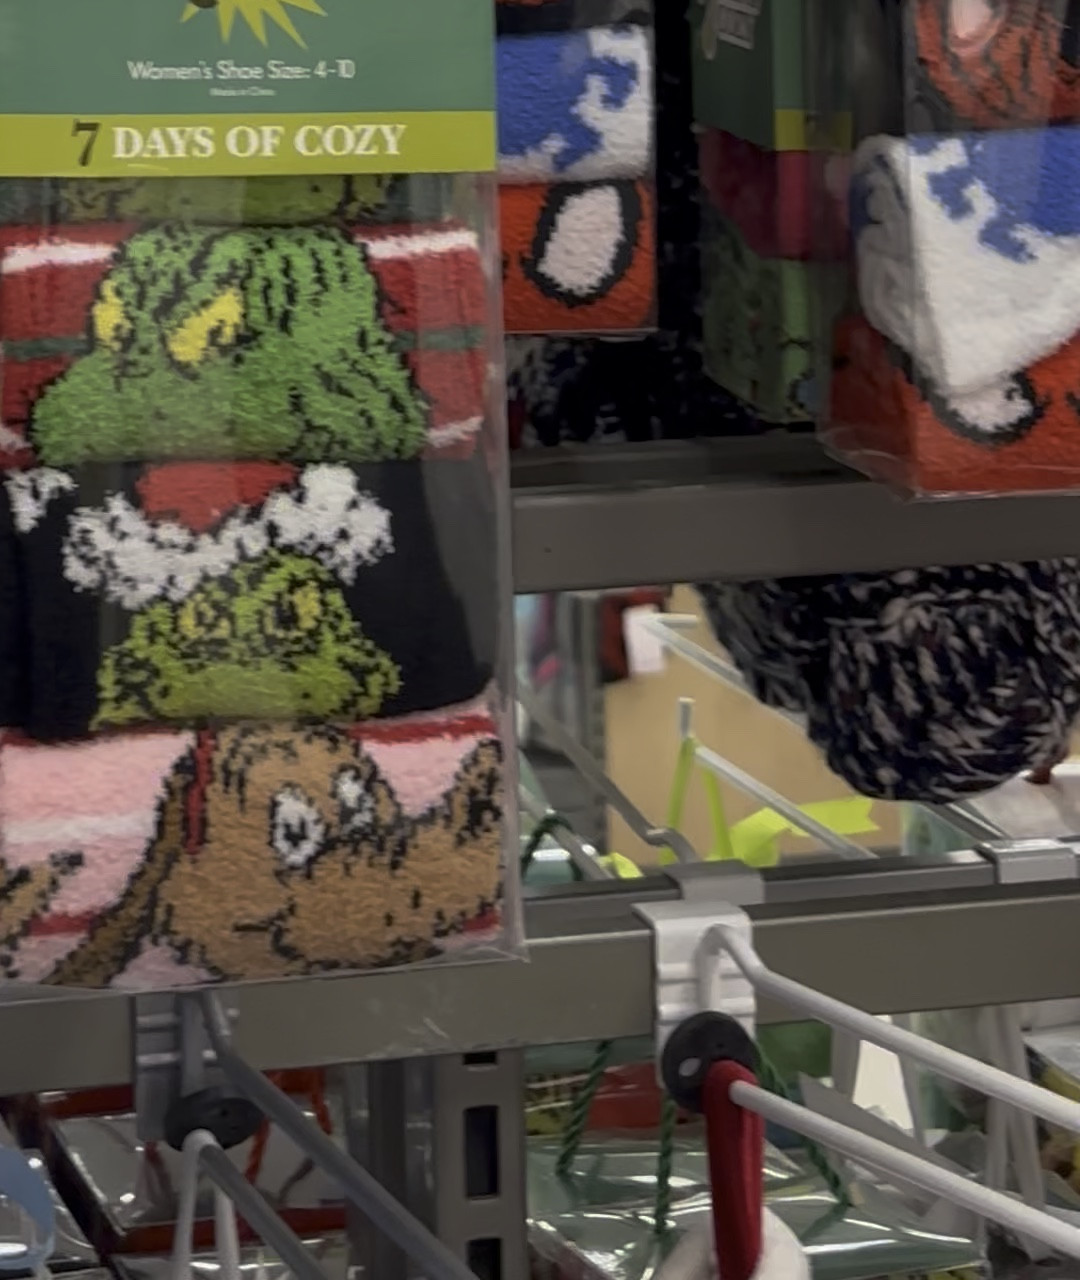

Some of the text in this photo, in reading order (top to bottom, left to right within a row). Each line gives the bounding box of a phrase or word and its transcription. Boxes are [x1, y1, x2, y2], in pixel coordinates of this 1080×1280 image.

[127, 58, 356, 80] Women's Shoe Size: 4-10
[71, 119, 407, 167] 7 DAYS OF COZY
